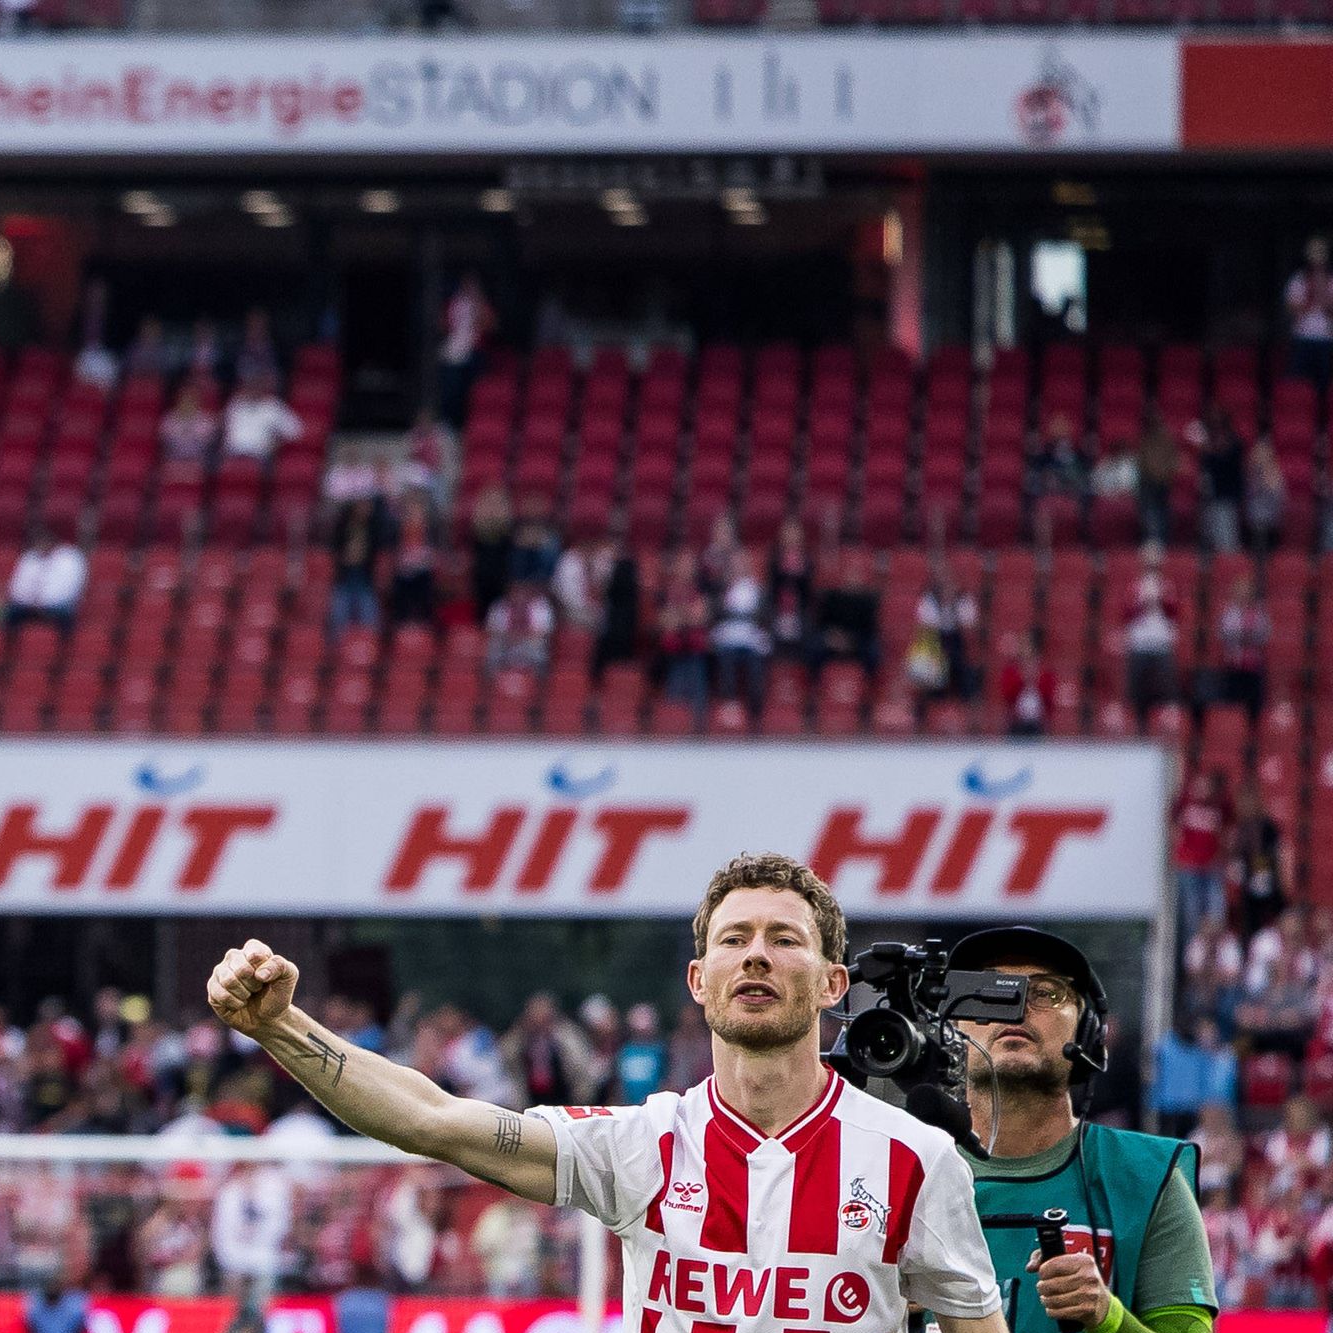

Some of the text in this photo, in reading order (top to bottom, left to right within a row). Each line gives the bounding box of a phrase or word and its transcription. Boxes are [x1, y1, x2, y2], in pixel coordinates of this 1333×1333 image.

[382, 806, 693, 895] HIT
[806, 807, 1109, 897] HIT
[996, 979, 1020, 987] SONY
[664, 1199, 703, 1214] hummel
[648, 1250, 811, 1320] REWE
